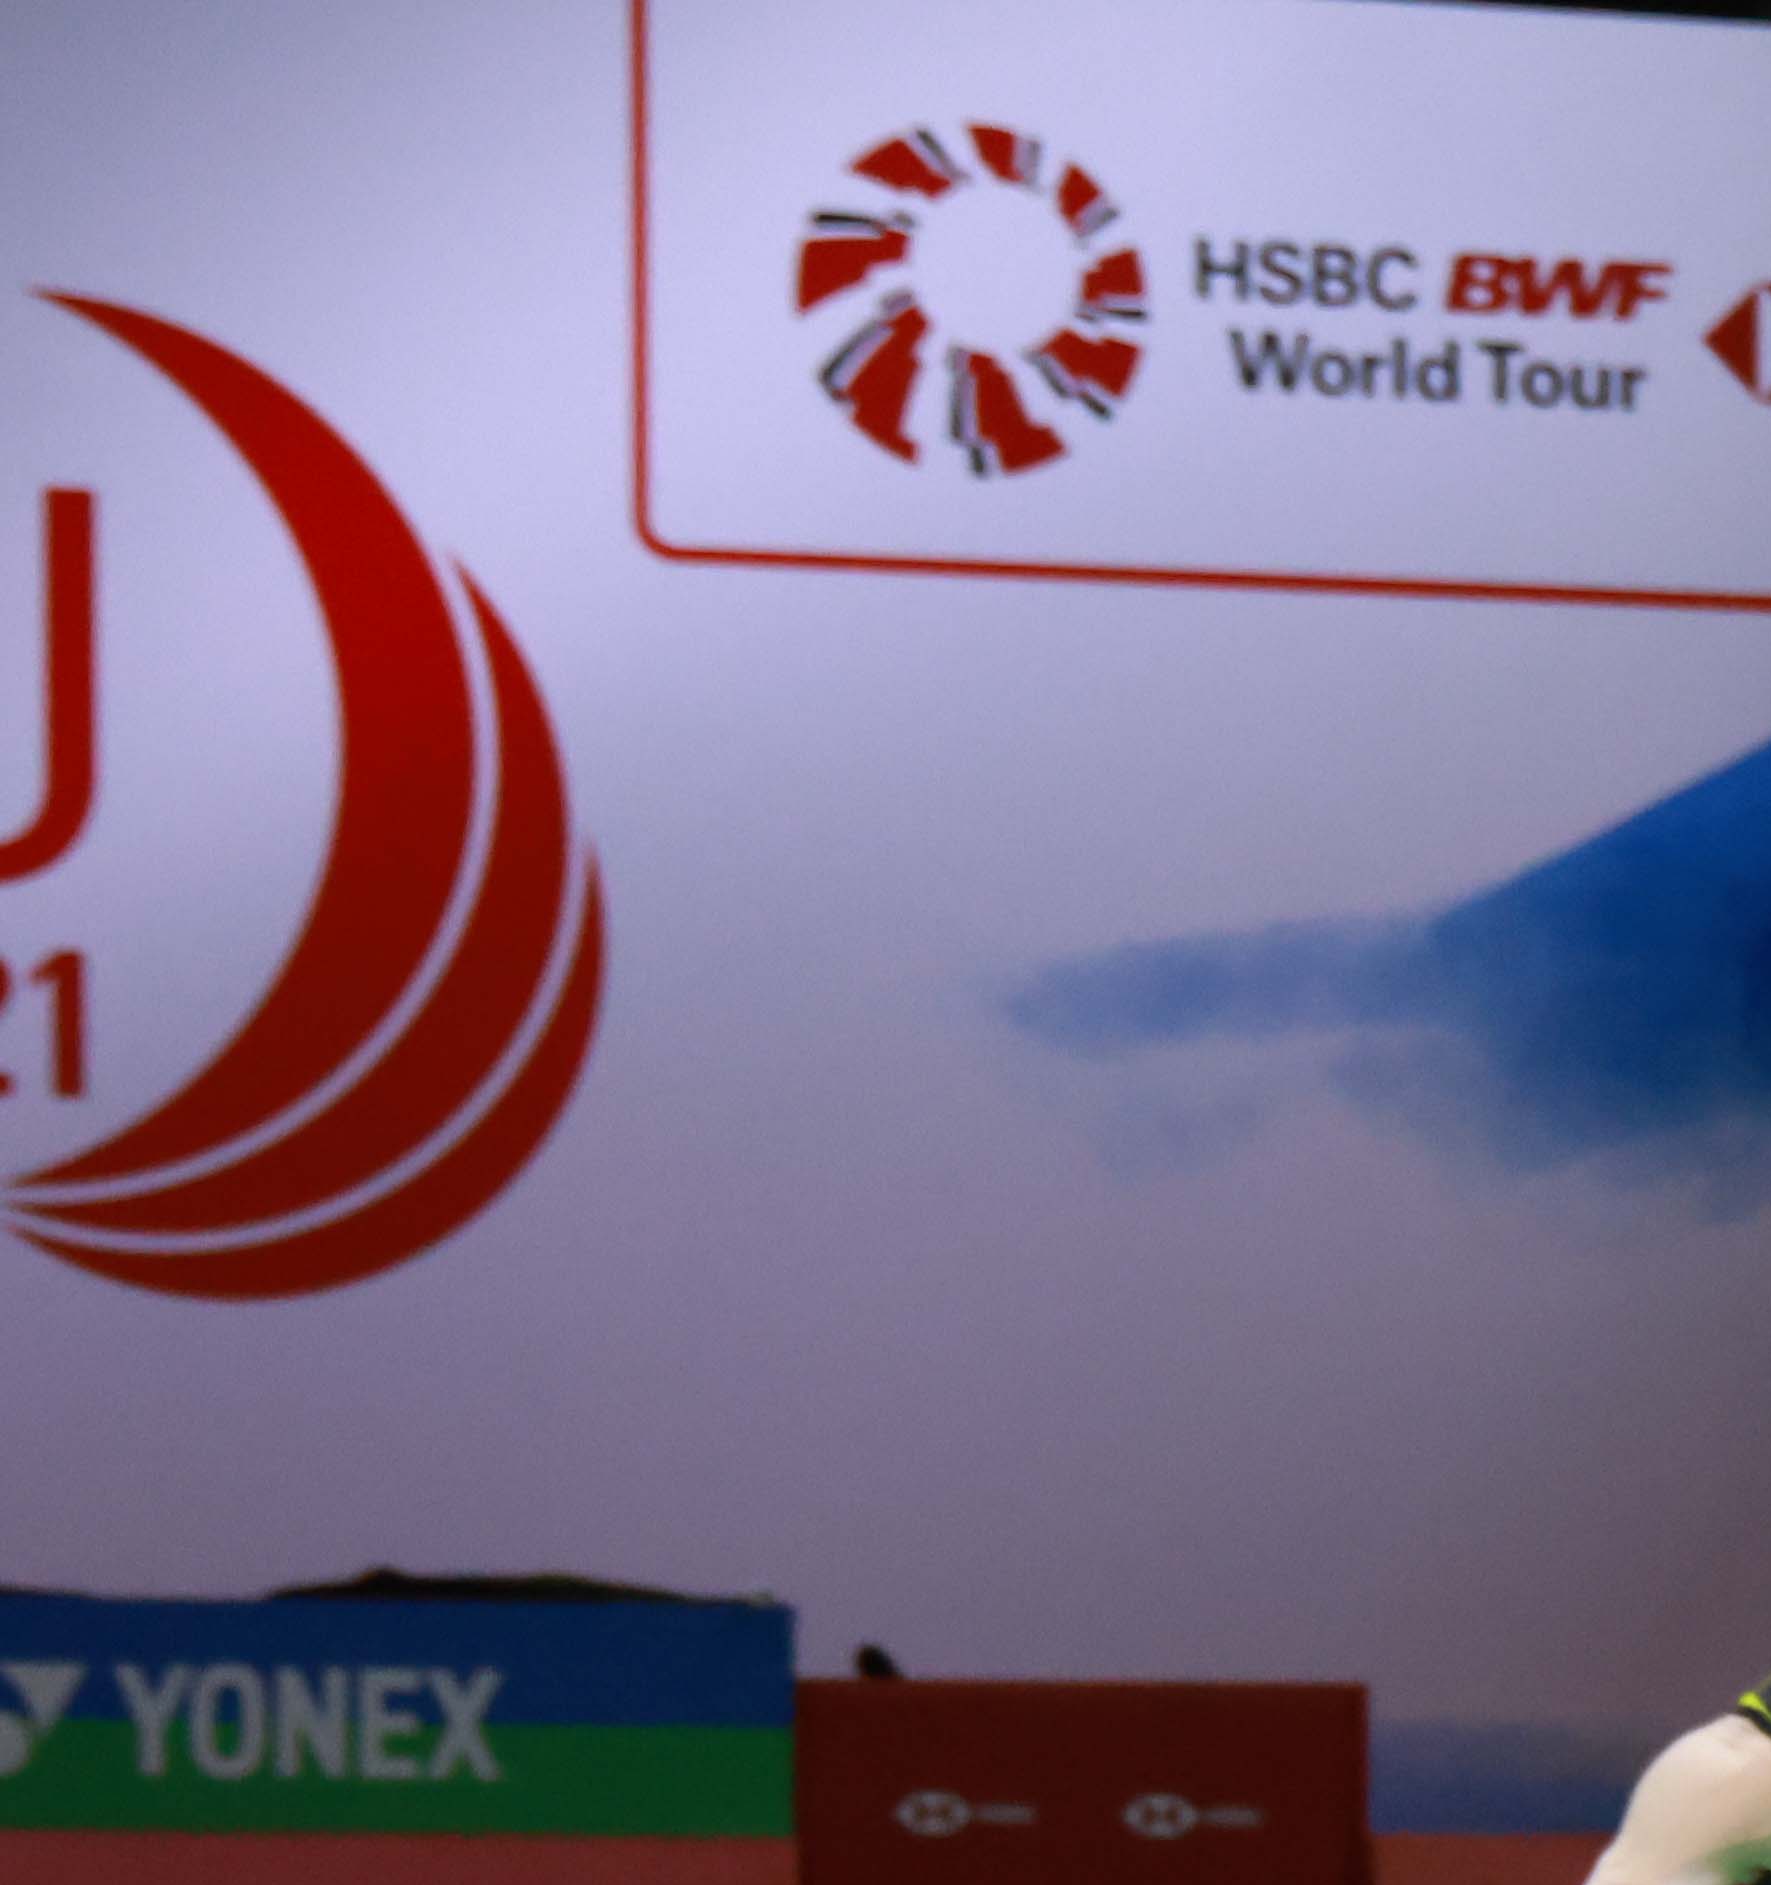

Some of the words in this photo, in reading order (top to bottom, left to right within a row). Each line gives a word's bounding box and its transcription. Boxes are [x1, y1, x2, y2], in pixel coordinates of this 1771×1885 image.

[1196, 238, 1420, 311] HSBC
[1443, 250, 1674, 320] BWF
[1229, 326, 1461, 404] World
[1476, 342, 1648, 412] Tour
[115, 1662, 504, 1782] YONEX
